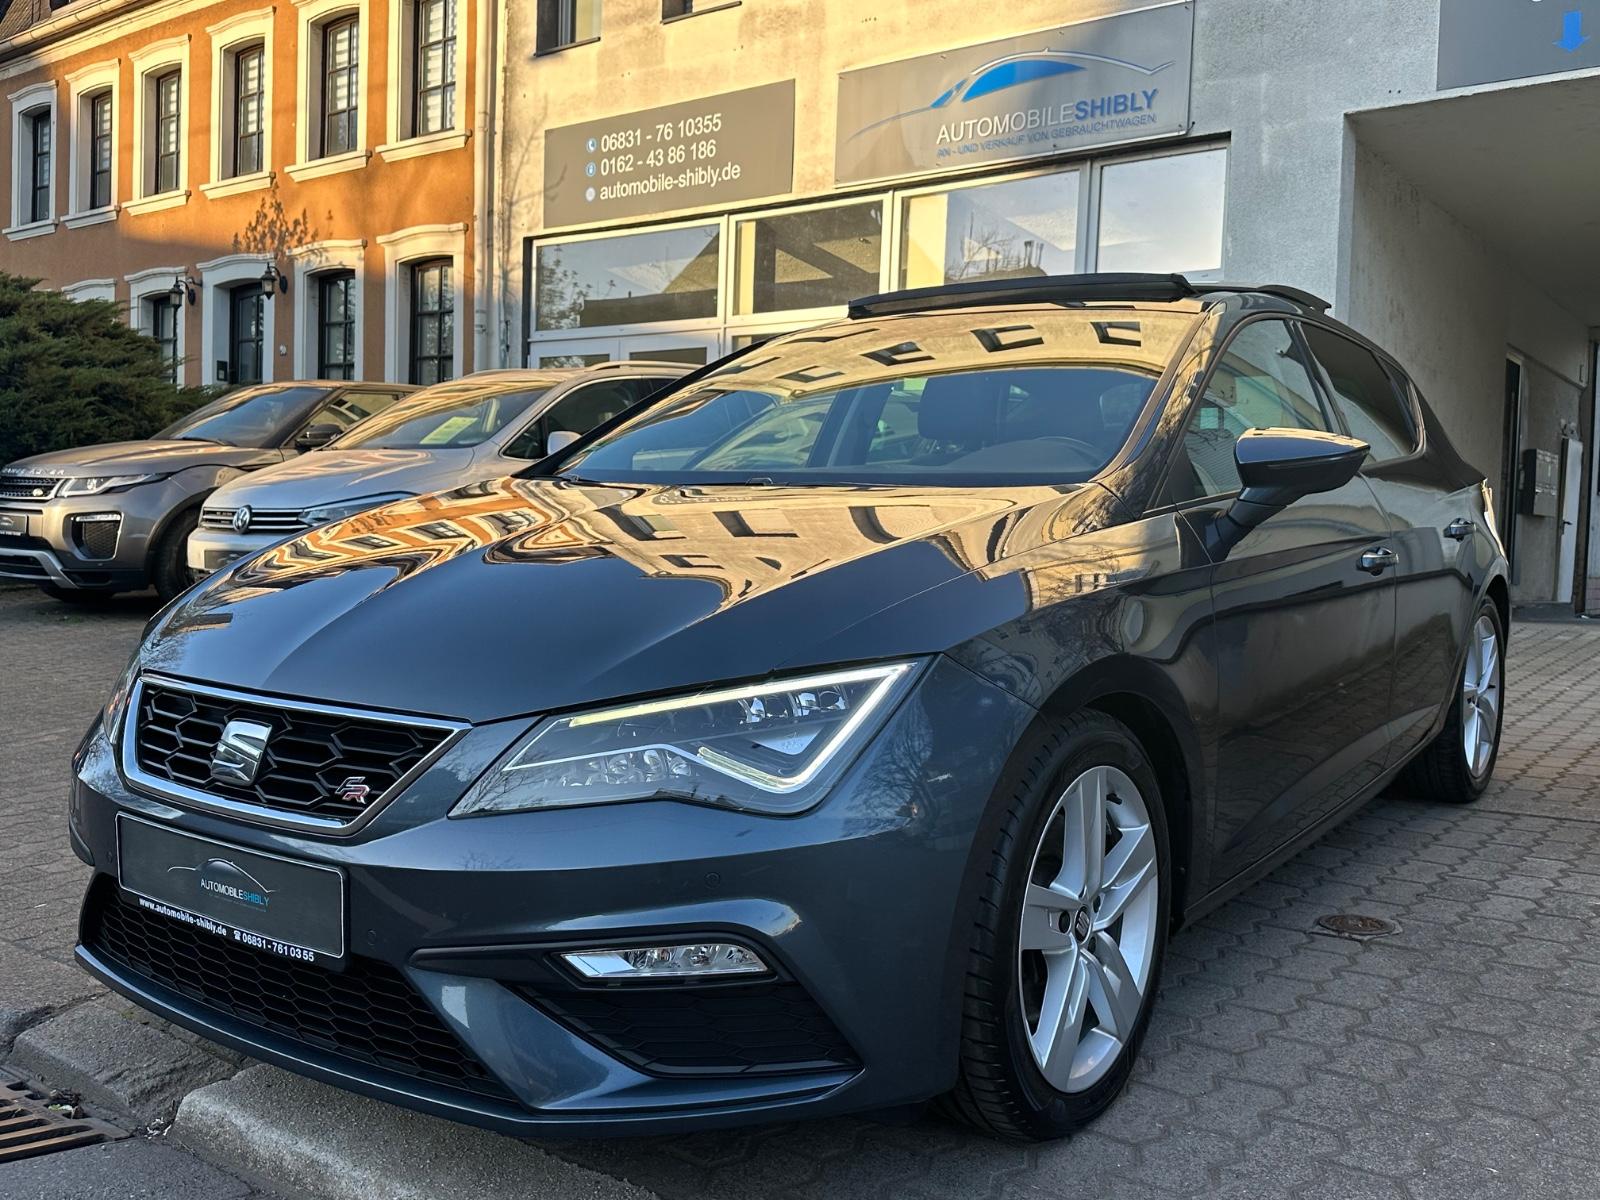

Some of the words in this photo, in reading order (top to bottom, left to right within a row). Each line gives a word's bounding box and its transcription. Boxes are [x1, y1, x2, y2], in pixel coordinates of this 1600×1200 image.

[601, 129, 642, 152] 06831
[656, 123, 673, 142] 76
[678, 113, 722, 138] 10355
[936, 88, 1158, 145] AUTOMOBILESHIBLY
[958, 143, 979, 154] UND
[980, 133, 1026, 151] VERKAUF
[1027, 129, 1049, 144] VON
[1051, 113, 1157, 139] GEBRAUCHTWAGEN
[601, 154, 634, 176] 0162
[646, 149, 664, 167] 43
[668, 145, 685, 164] 86
[690, 139, 717, 160] 186
[600, 161, 741, 200] automobile-shibly.de
[139, 898, 227, 936] www.automobile-shibly.de
